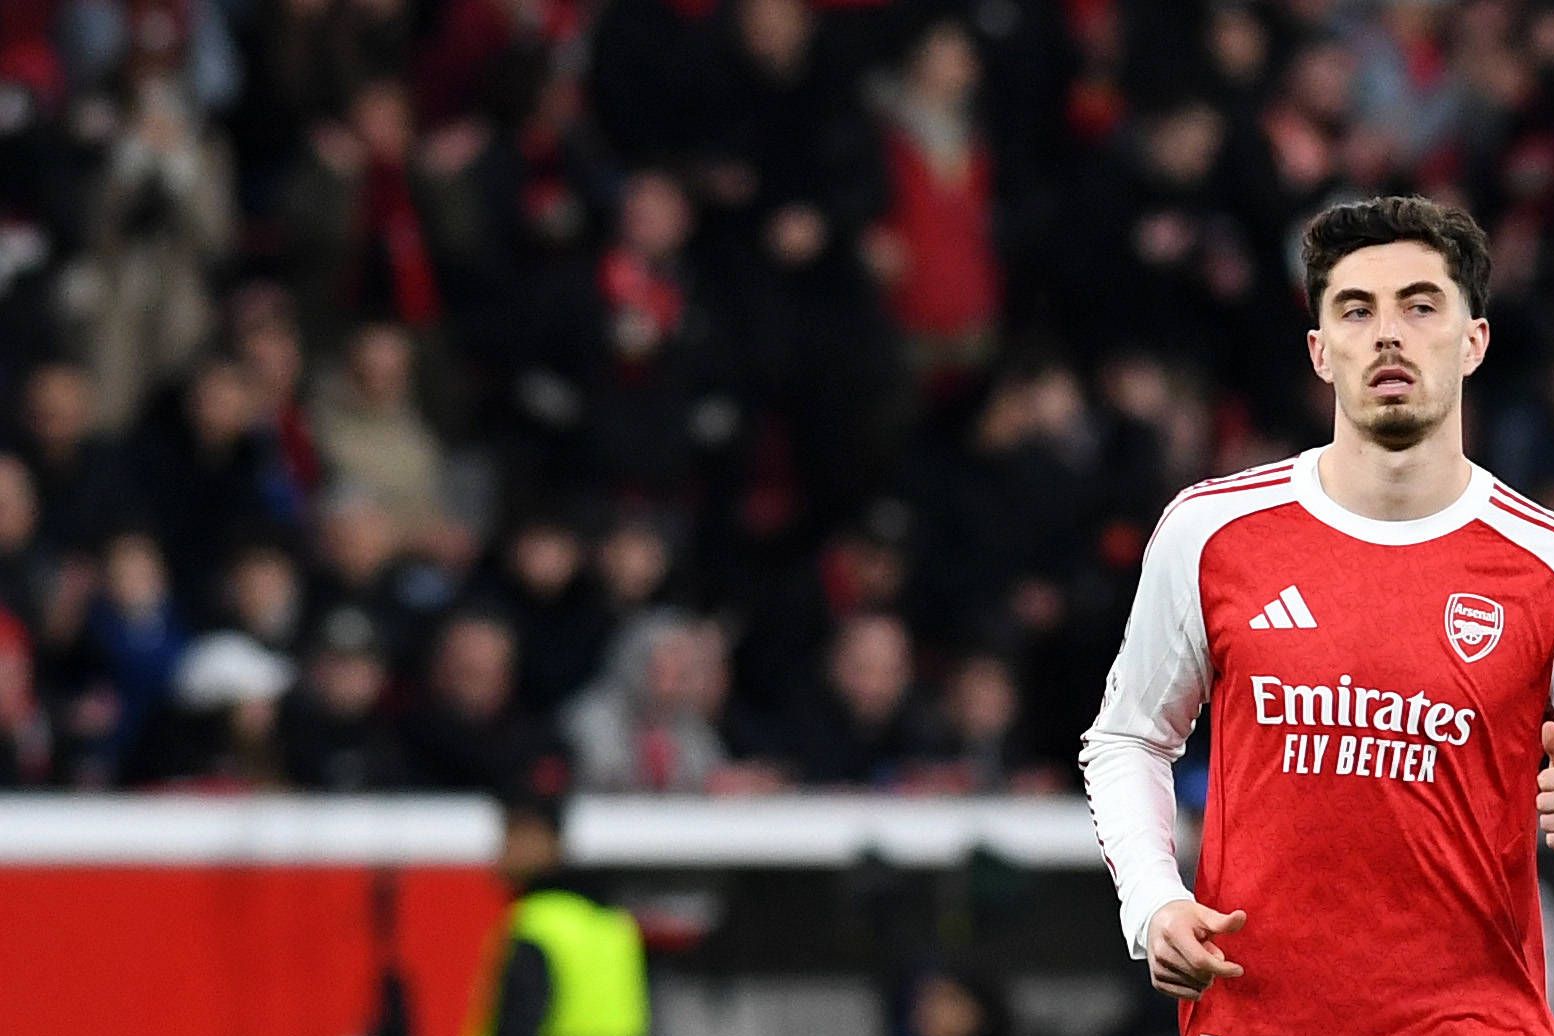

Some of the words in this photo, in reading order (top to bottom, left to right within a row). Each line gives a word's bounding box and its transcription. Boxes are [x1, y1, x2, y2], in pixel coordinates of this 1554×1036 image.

[1454, 602, 1497, 623] Arsenal
[1250, 674, 1476, 746] Emirates
[1282, 734, 1330, 774] FLY
[1335, 735, 1438, 783] BETTER
